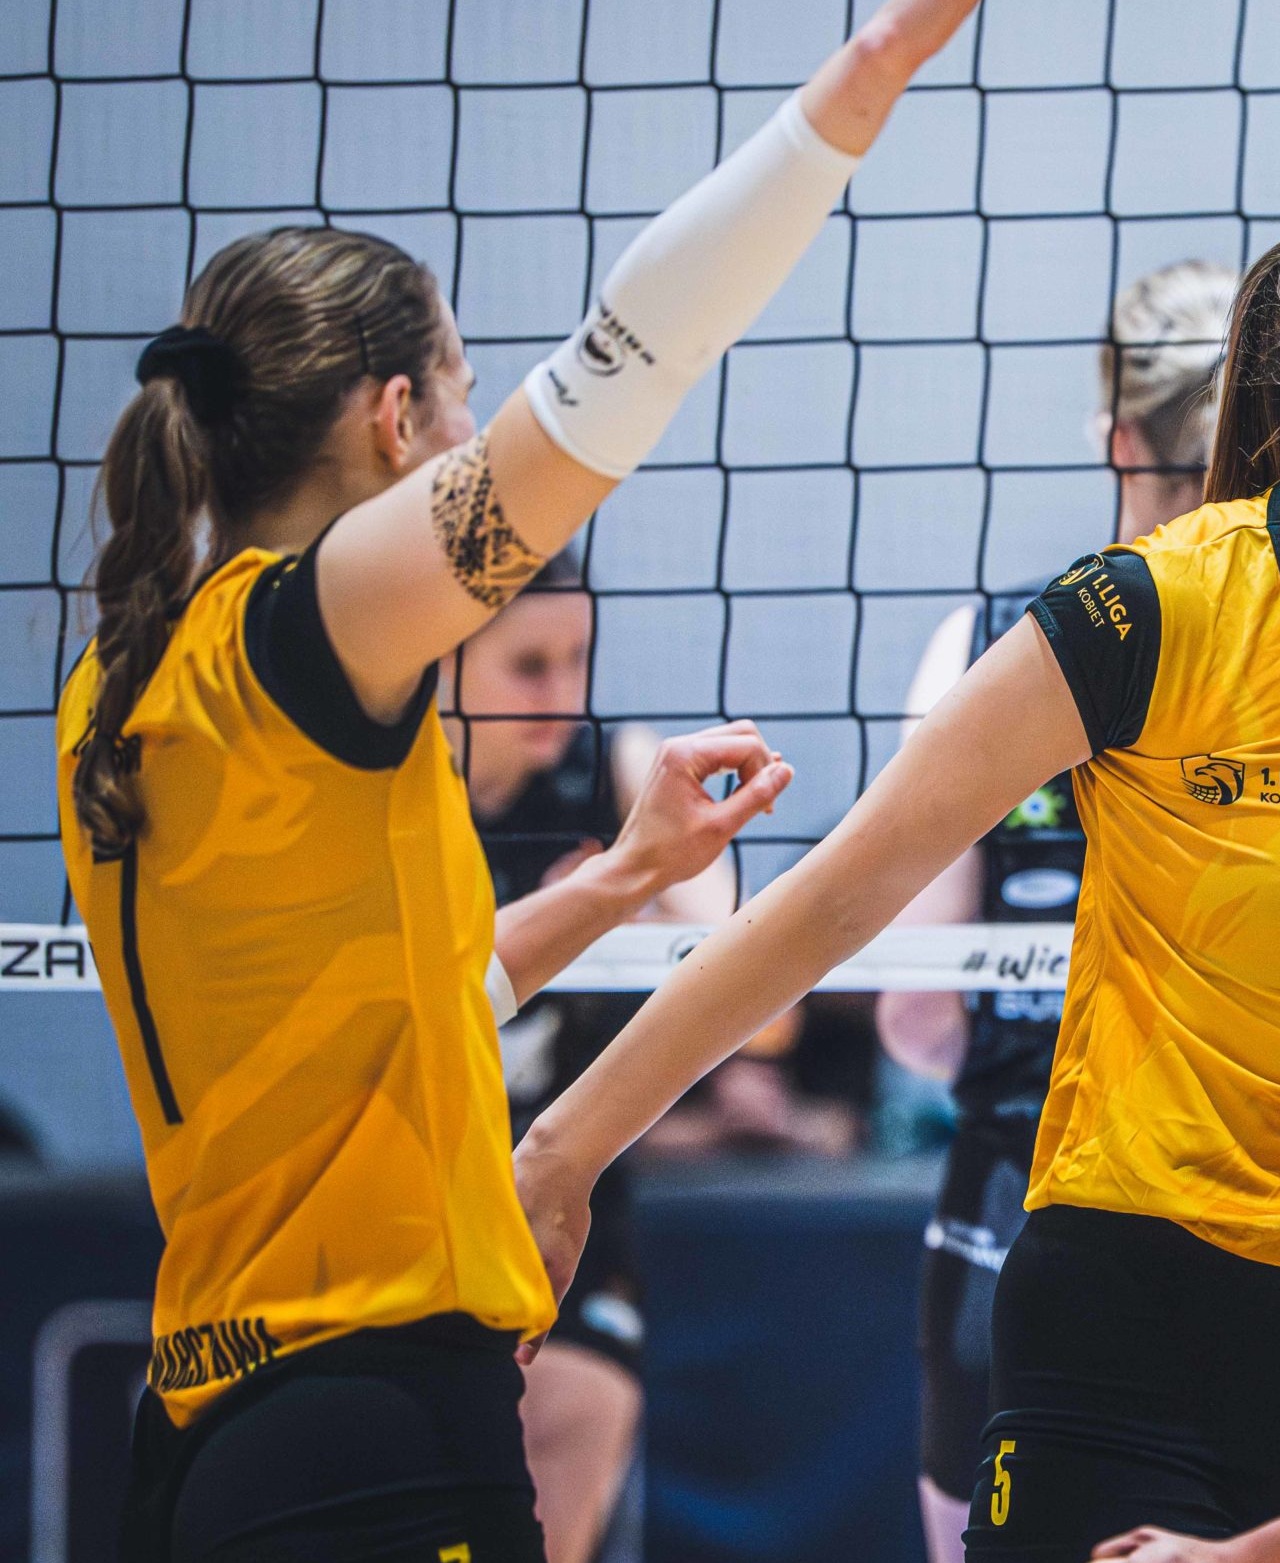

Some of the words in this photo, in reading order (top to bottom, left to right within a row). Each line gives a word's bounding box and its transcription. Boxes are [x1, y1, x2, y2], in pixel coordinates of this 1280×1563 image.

[1077, 587, 1105, 627] KOBIET
[0, 940, 99, 978] ZA
[991, 1440, 1016, 1526] 5
